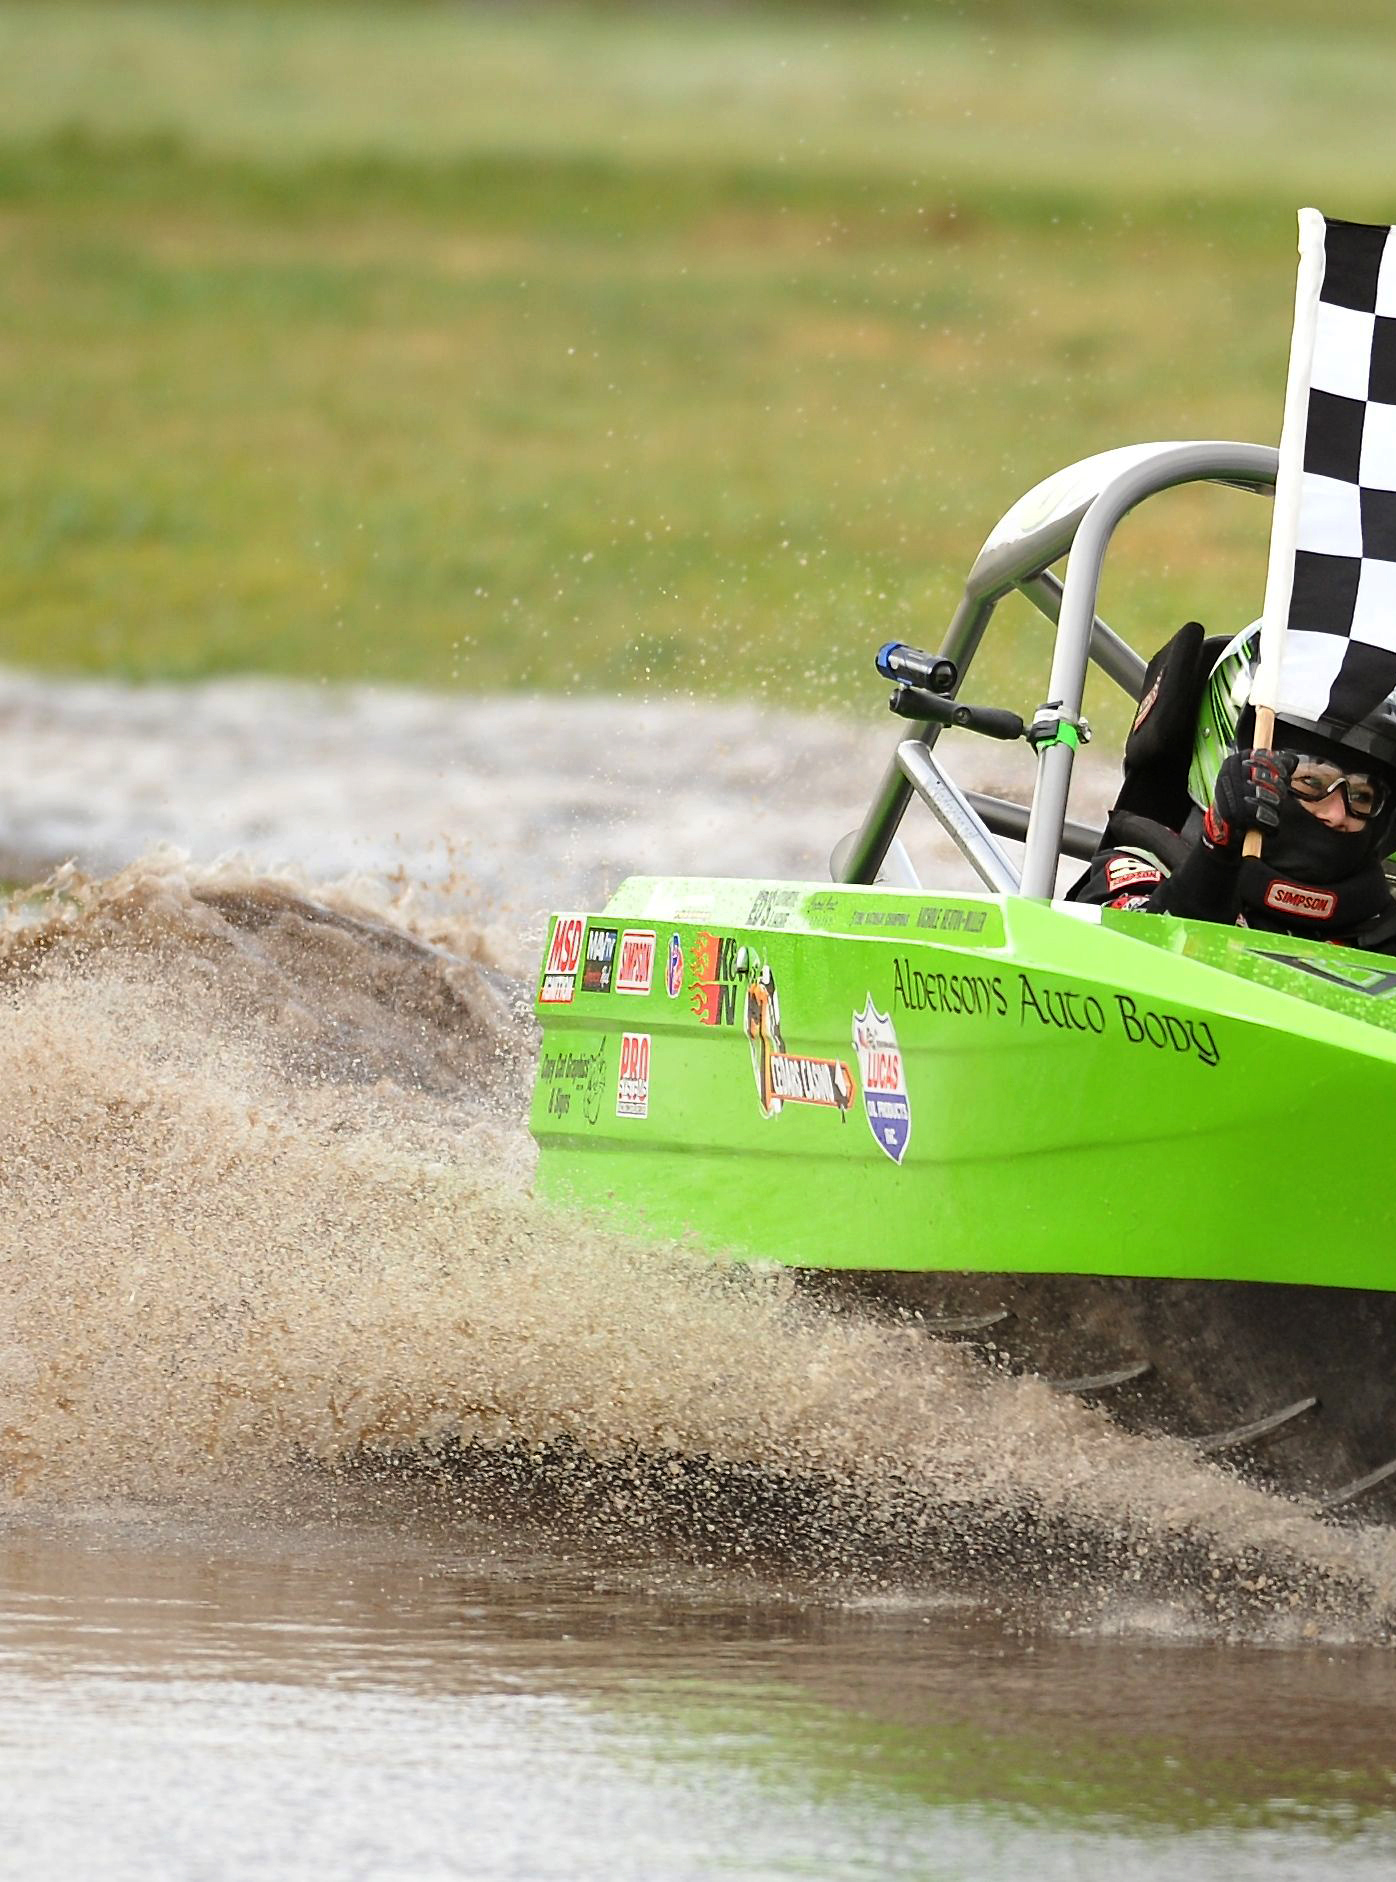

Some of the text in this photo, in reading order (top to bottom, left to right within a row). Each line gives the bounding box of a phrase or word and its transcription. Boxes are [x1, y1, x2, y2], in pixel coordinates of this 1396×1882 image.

[1274, 889, 1329, 911] SIMPSON
[548, 919, 582, 972] MSD
[621, 1037, 649, 1080] PRO
[867, 1053, 899, 1089] LUCAS
